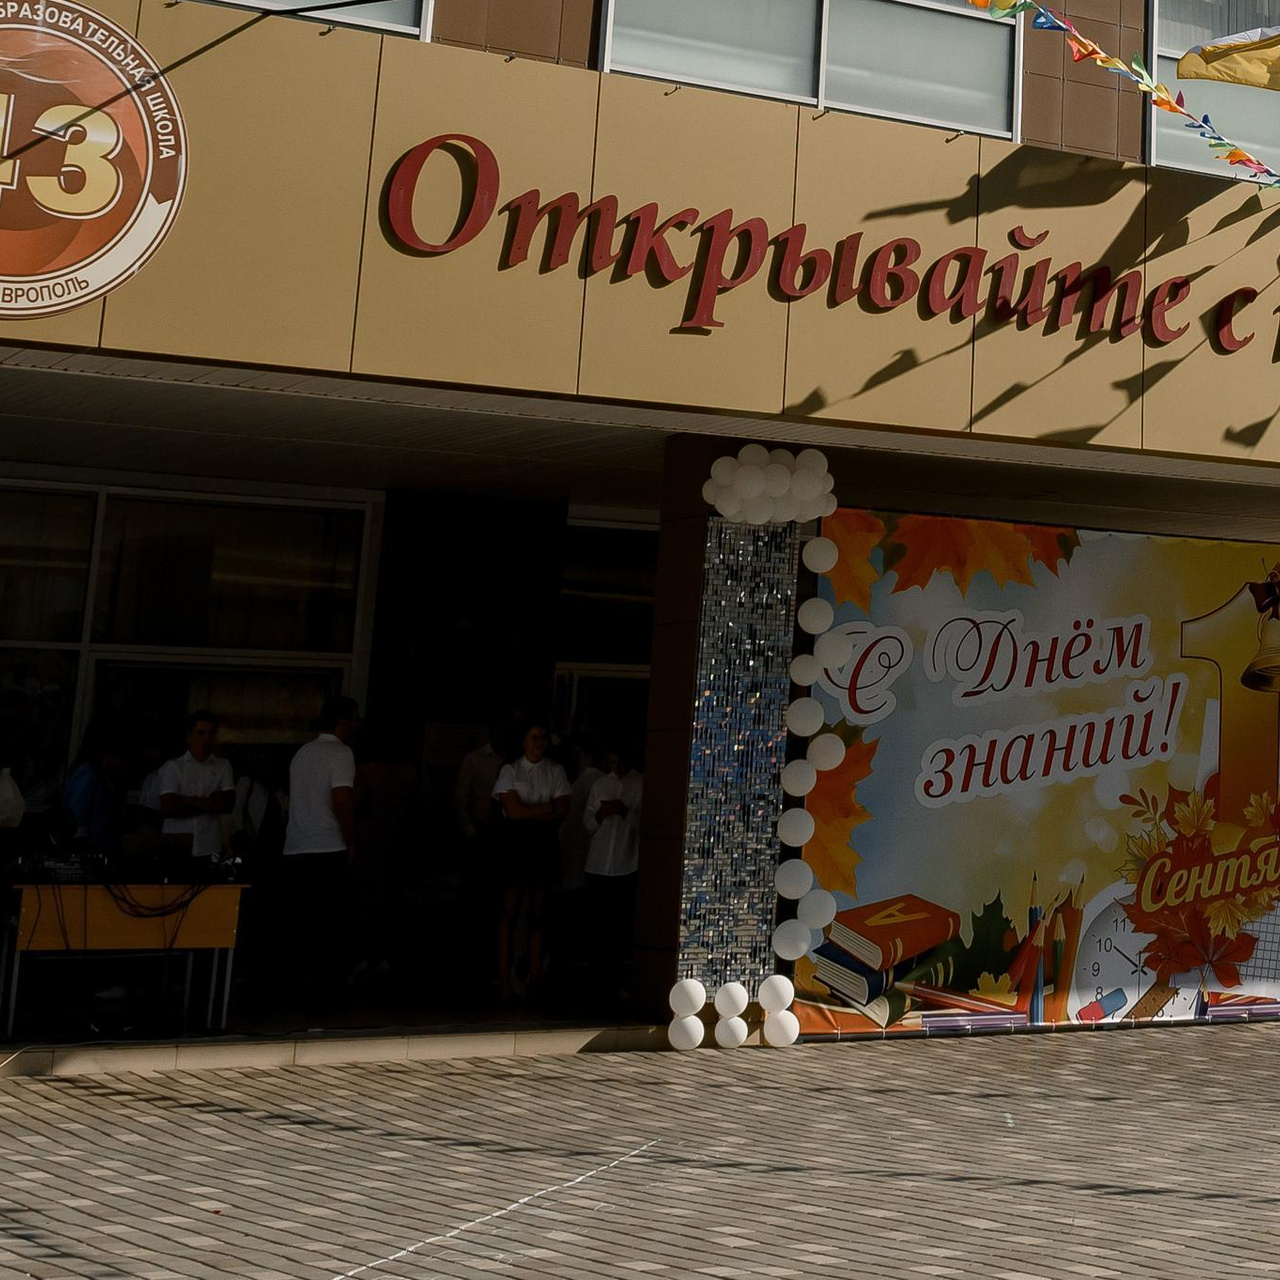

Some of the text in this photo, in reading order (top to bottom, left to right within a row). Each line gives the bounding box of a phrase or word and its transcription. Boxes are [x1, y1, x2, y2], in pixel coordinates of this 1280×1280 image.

[0, 93, 121, 217] 3
[145, 92, 176, 159] ШКОЛА
[386, 133, 1191, 344] Открывайте
[1215, 285, 1259, 353] с
[1, 276, 90, 304] ВРОПОЛЬ
[823, 616, 1147, 715] С Днём
[921, 681, 1184, 800] знаний!
[1096, 937, 1113, 953] 10
[1112, 918, 1127, 933] 11
[1091, 961, 1101, 977] 9
